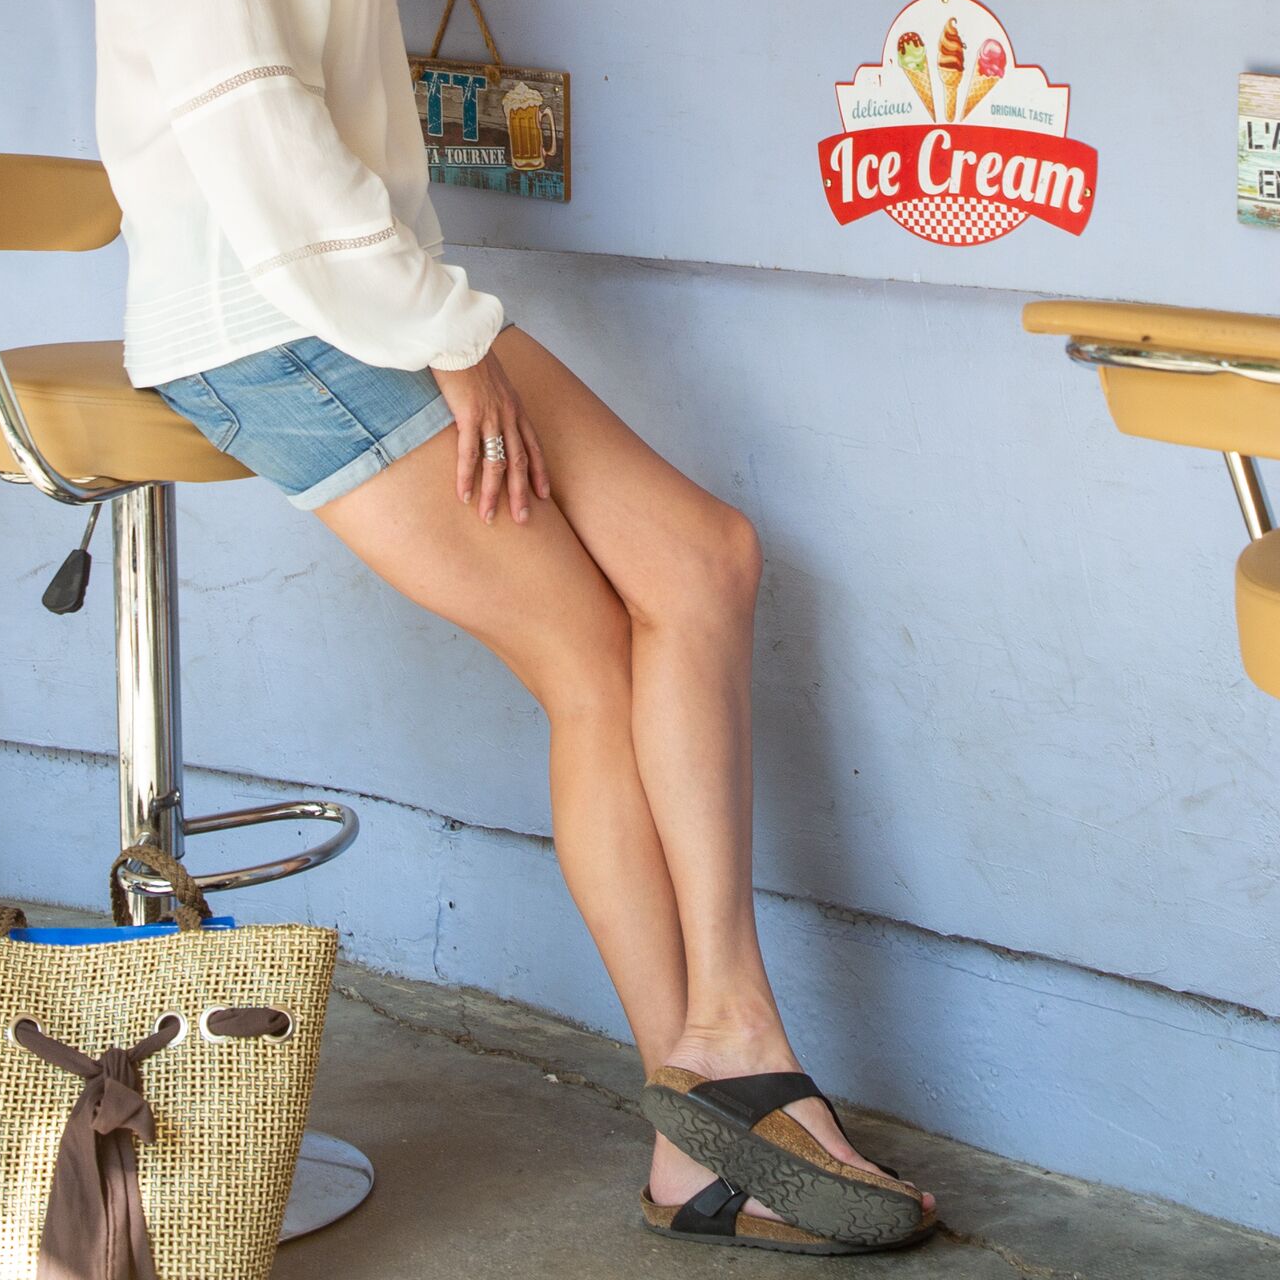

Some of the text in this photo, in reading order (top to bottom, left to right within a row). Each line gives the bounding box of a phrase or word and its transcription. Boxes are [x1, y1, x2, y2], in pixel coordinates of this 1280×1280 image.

[413, 70, 487, 142] TT
[852, 98, 1055, 126] delicious ORIGINAL TASTE
[445, 148, 506, 165] TOURNEE
[830, 129, 1086, 214] Ice Cream
